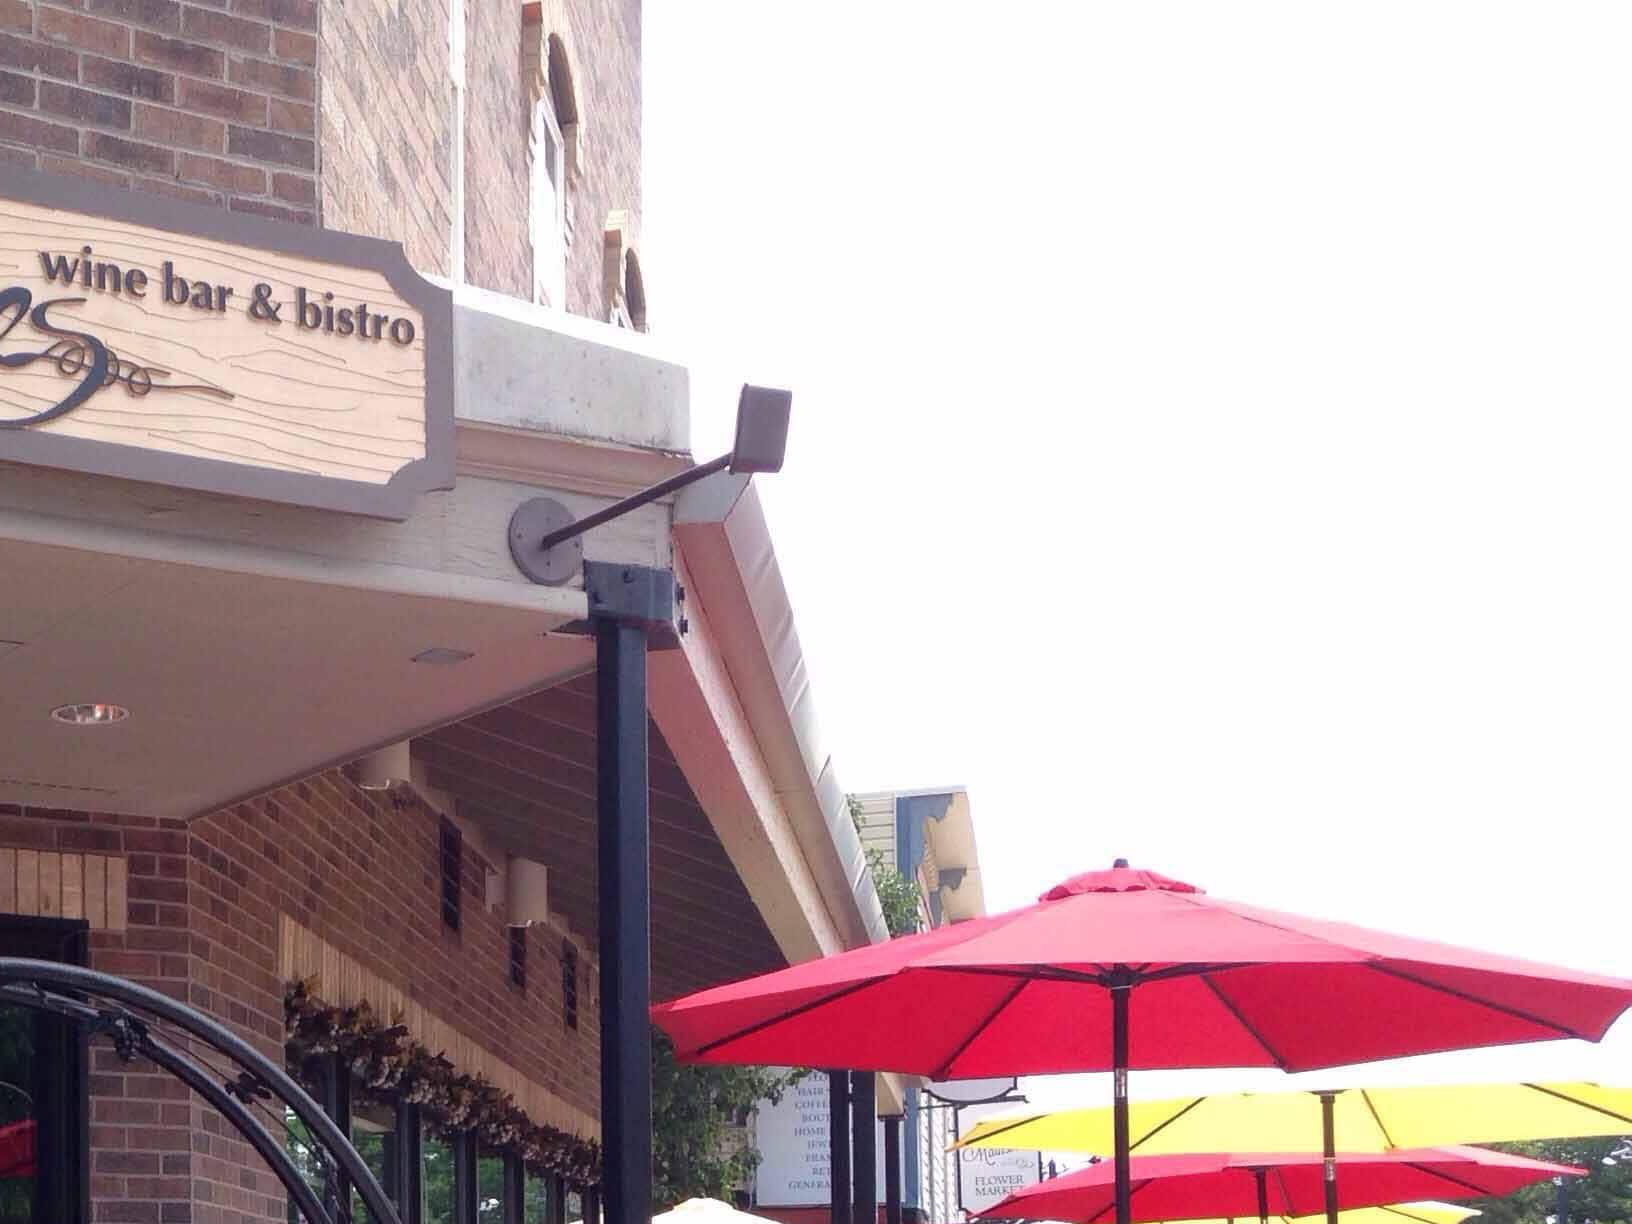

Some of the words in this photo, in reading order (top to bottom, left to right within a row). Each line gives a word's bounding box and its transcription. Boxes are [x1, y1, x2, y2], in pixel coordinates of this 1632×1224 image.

[38, 246, 148, 298] wine
[161, 260, 233, 313] bar
[248, 282, 282, 325] &
[295, 286, 416, 346] bistro
[795, 1100, 830, 1109] COFFE
[802, 1113, 831, 1123] BOUT
[794, 1127, 826, 1137] HOME
[975, 1174, 1025, 1186] FLOWER
[788, 1181, 831, 1191] GENERA
